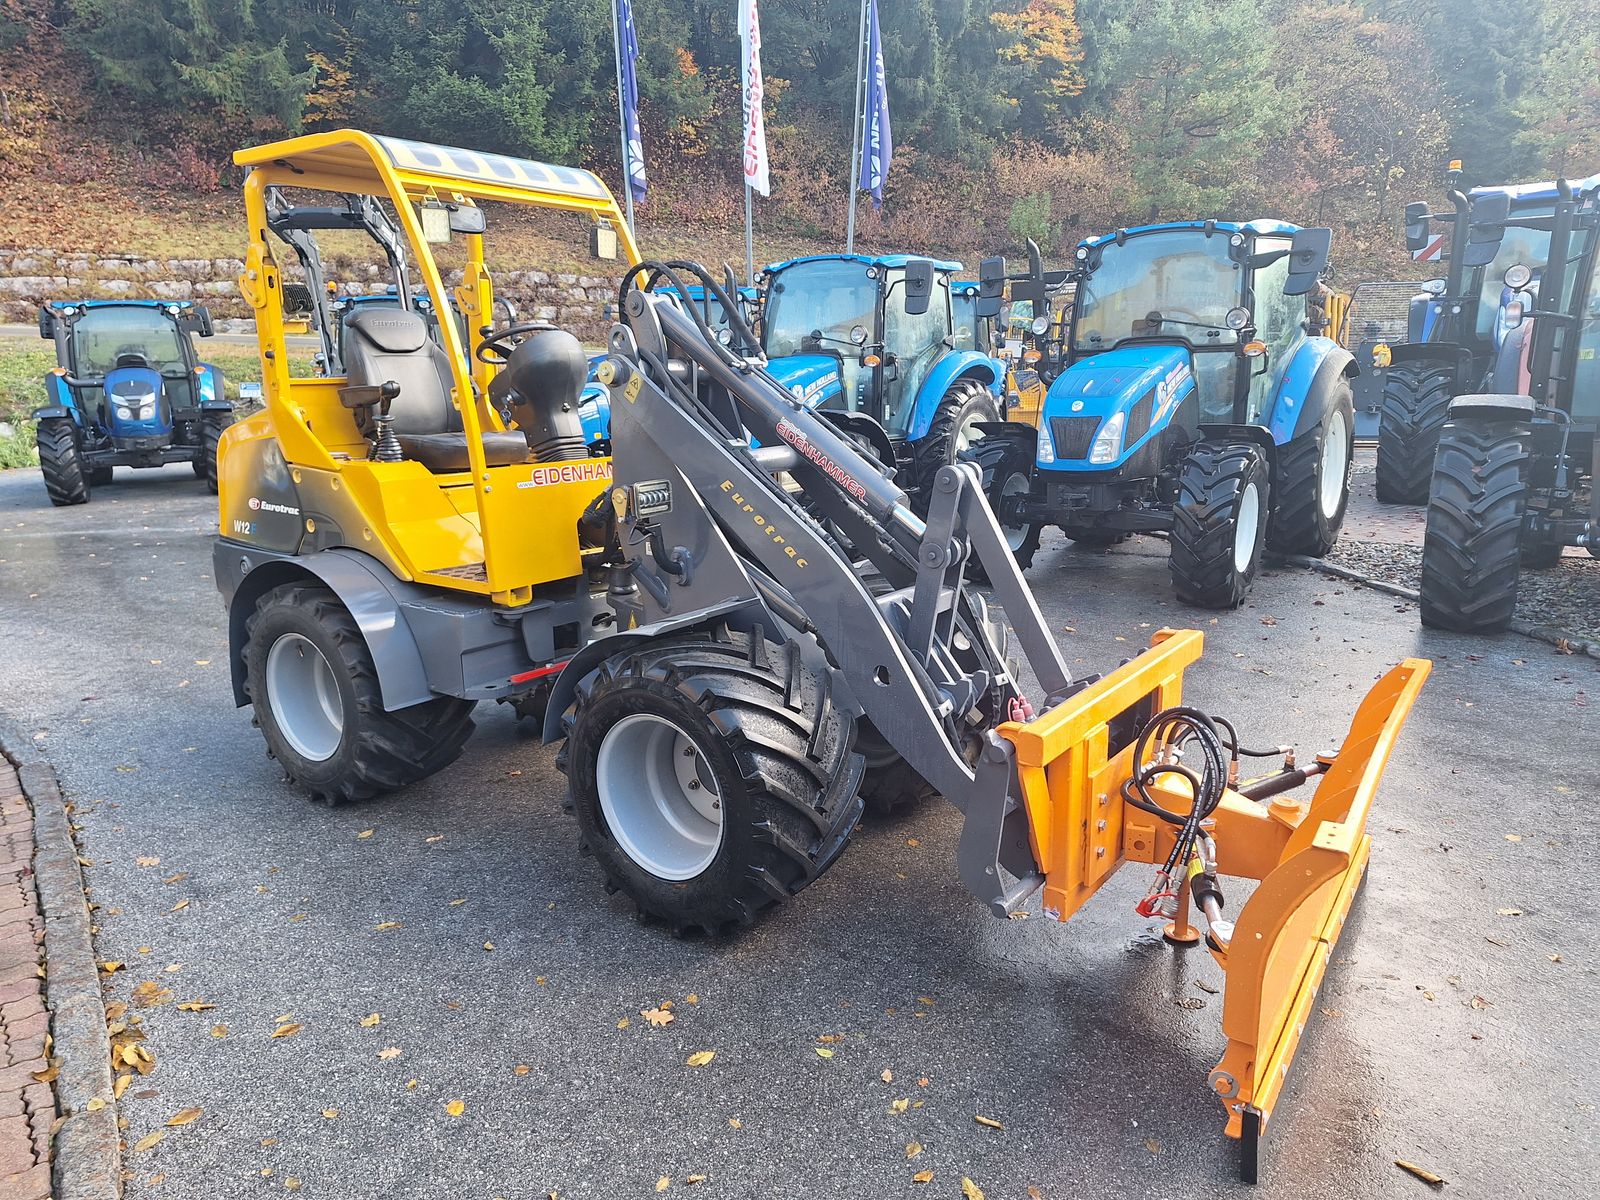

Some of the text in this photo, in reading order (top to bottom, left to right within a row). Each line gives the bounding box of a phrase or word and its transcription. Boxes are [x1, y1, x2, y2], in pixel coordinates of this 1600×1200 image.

[777, 422, 866, 501] EIDENHAMMER
[260, 500, 300, 515] Eurotrac
[720, 479, 808, 569] Eurotrac
